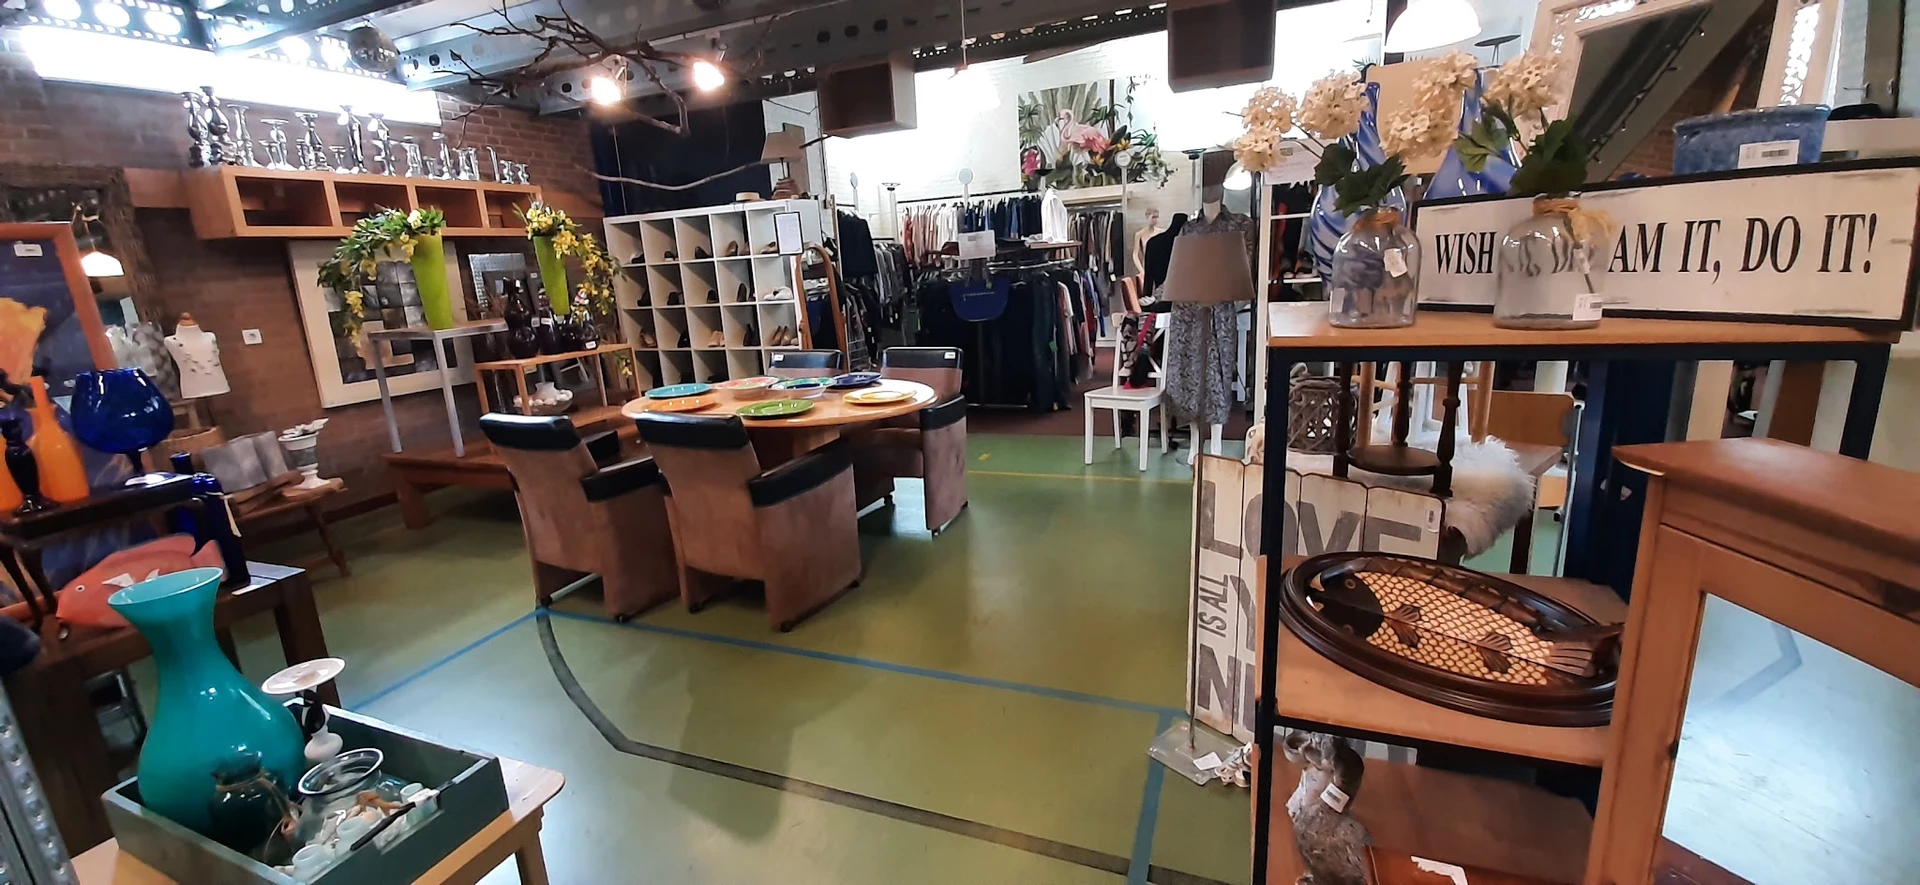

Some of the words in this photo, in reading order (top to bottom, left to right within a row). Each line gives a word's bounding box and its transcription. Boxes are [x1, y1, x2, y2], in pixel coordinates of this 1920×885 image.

[1435, 231, 1498, 275] WISH
[1677, 219, 1721, 284] IT,
[1739, 215, 1801, 274] DO
[1817, 212, 1878, 274] IT!
[1199, 574, 1229, 614] ALL
[1198, 610, 1227, 638] IS
